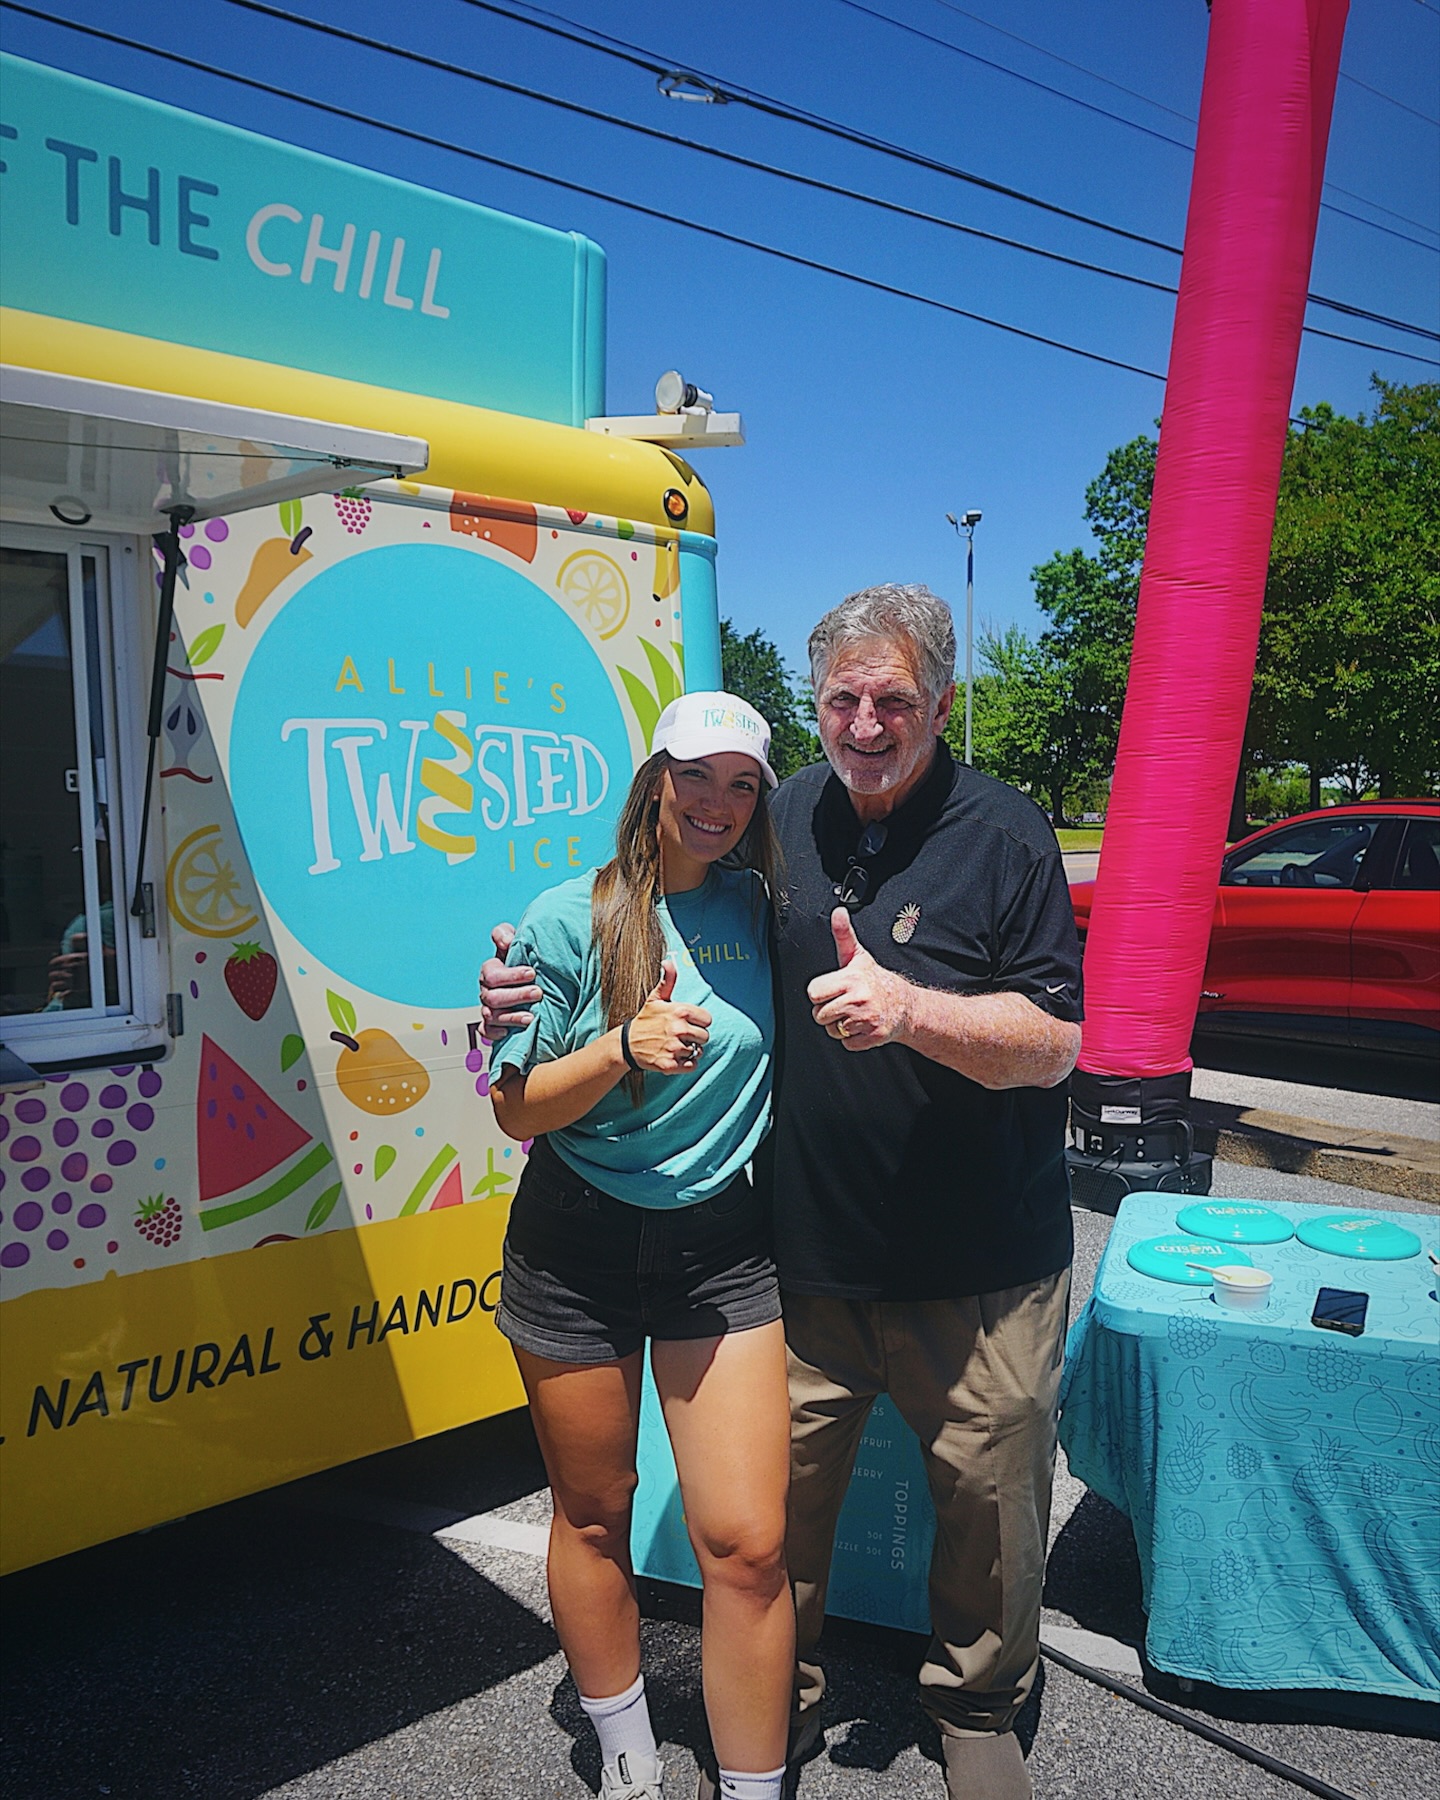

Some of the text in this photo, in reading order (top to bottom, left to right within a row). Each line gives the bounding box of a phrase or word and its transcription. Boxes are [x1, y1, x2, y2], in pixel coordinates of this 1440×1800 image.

[45, 137, 219, 260] THE
[246, 203, 450, 319] CHILL
[335, 655, 567, 713] ALLIE'S
[281, 710, 610, 876] TWISTED
[509, 836, 582, 872] ICE
[27, 1327, 281, 1438] NATURAL
[299, 1312, 334, 1361] &
[890, 1479, 909, 1571] TOPPINGS
